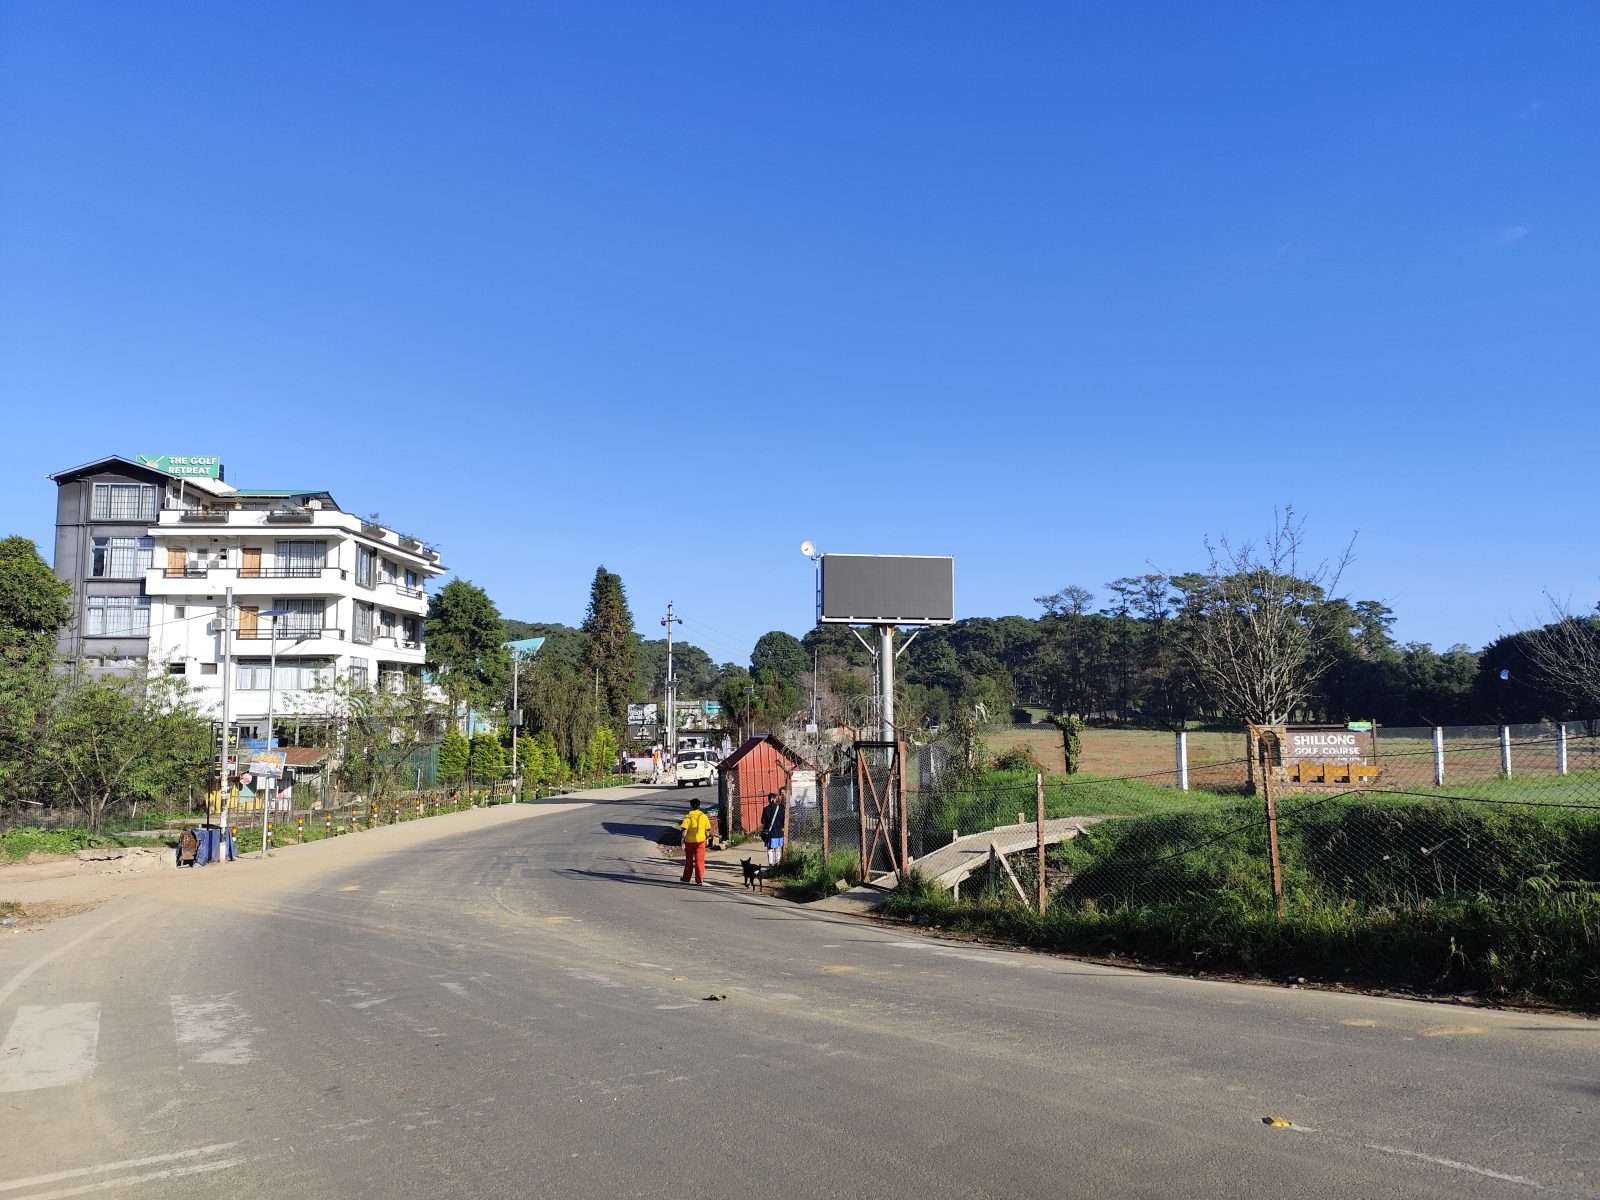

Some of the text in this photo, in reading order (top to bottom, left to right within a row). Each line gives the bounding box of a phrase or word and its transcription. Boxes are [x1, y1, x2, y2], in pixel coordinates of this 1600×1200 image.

[168, 457, 217, 465] THE GOLF
[168, 467, 211, 475] RETREAT
[1293, 735, 1356, 745] SHILLONG
[1294, 747, 1360, 755] GOLF COURSE
